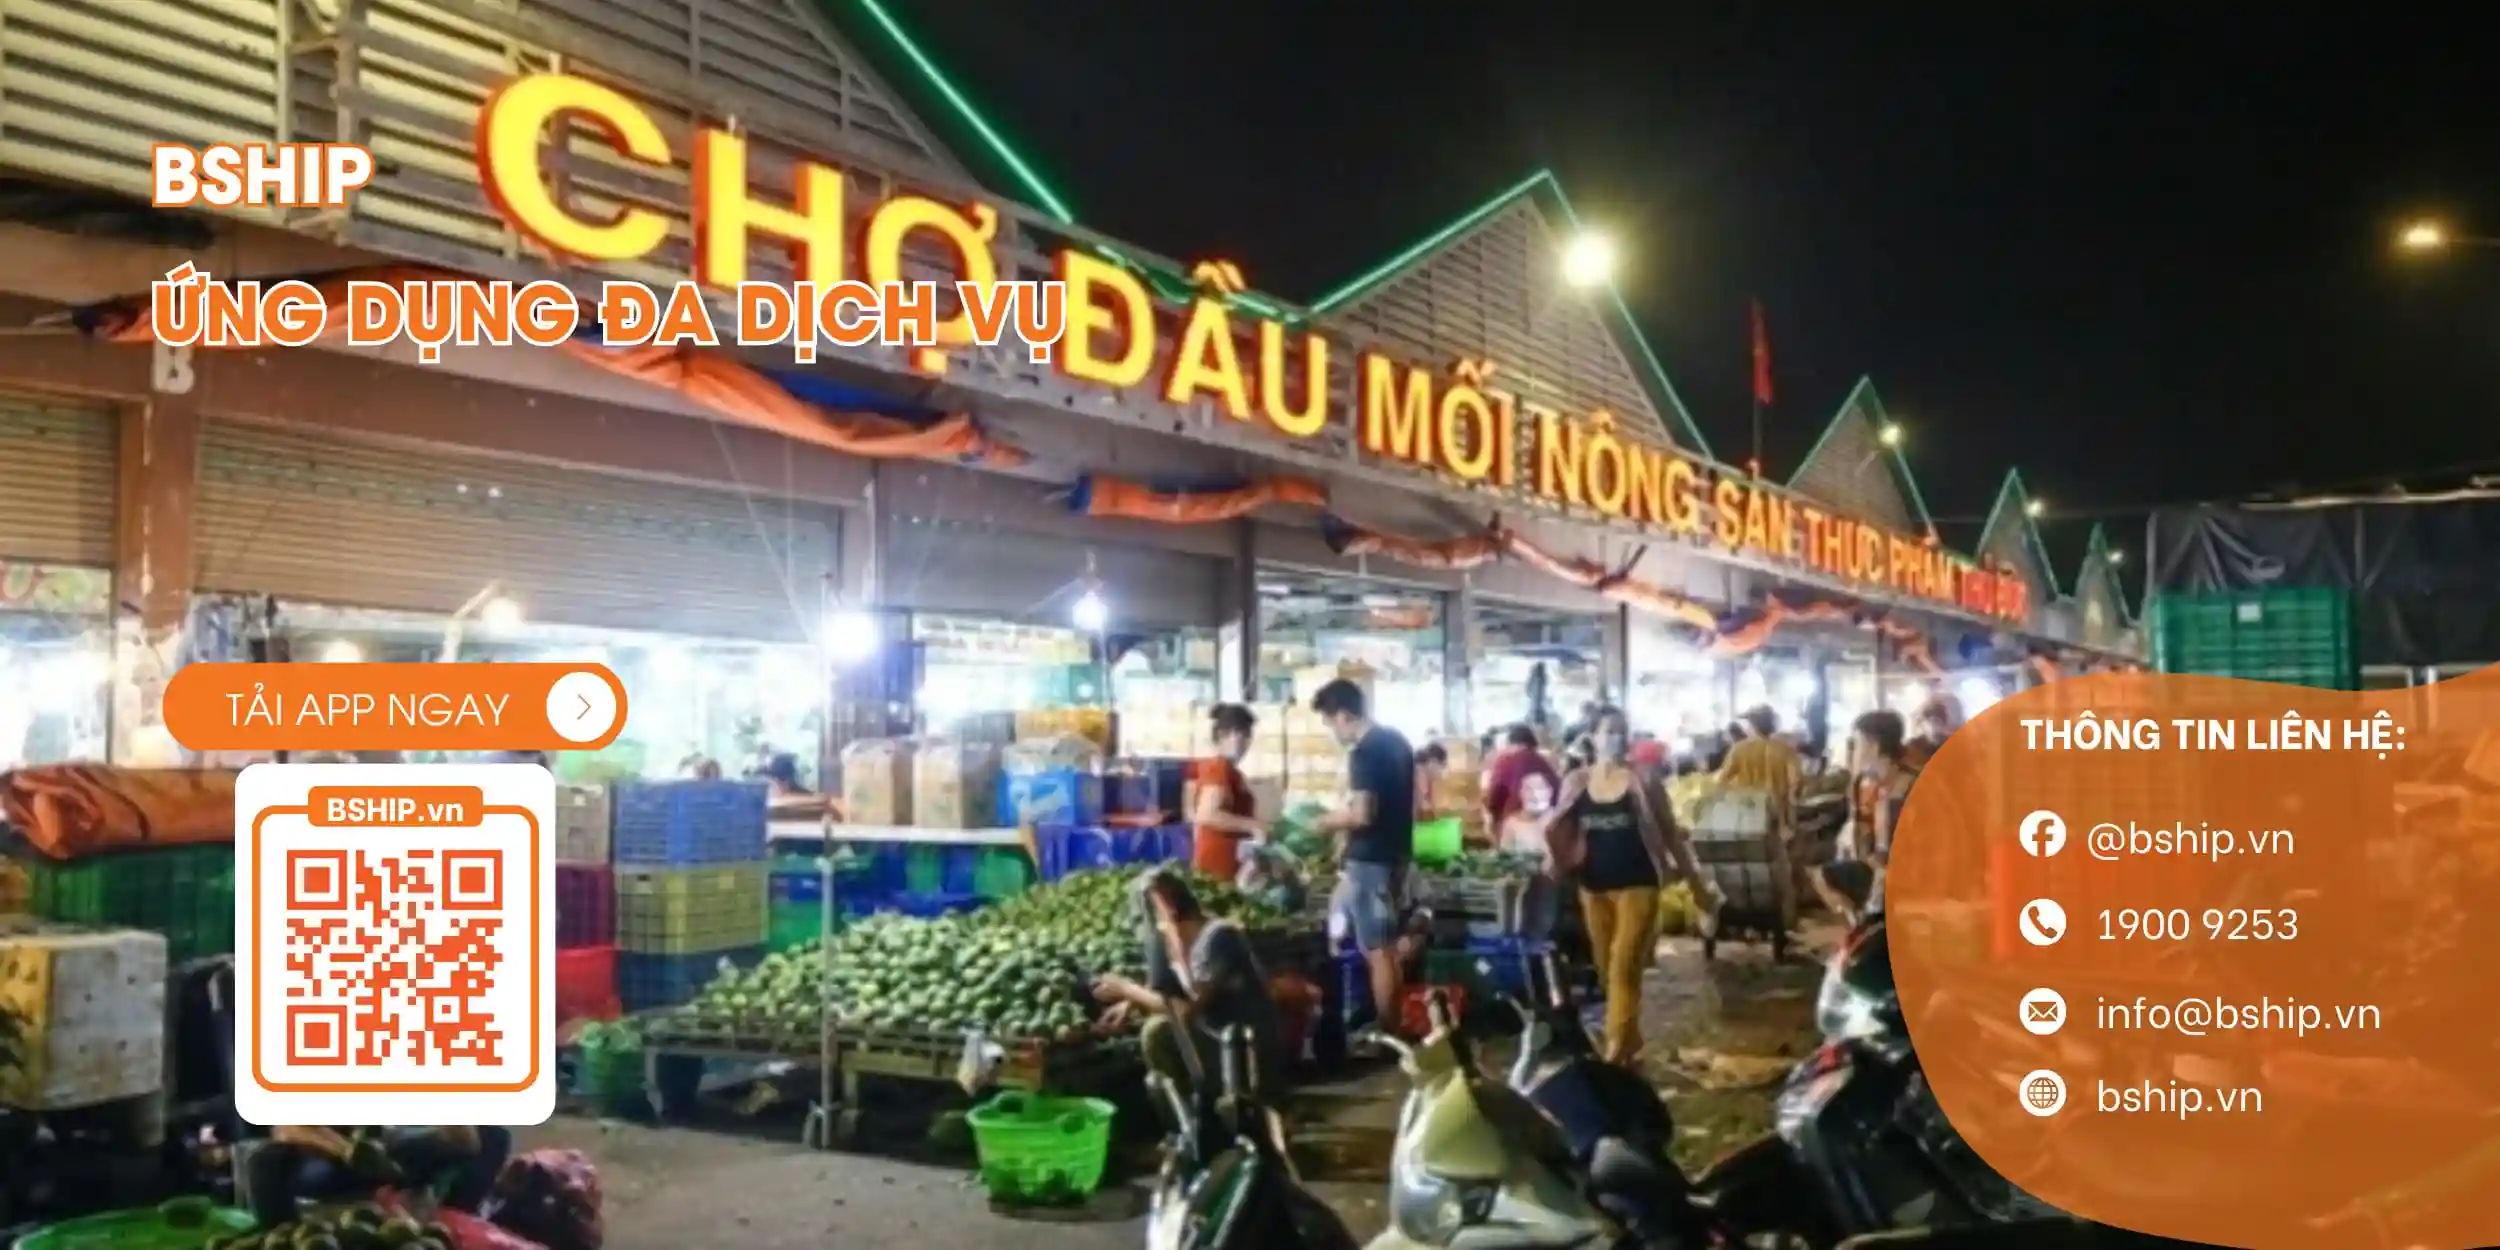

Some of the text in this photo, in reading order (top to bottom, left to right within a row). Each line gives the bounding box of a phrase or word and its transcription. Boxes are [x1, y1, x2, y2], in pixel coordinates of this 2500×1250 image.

[1054, 249, 1328, 437] ĐẦU
[1358, 353, 1514, 486] MỐI
[1534, 404, 1699, 532] NÔNG
